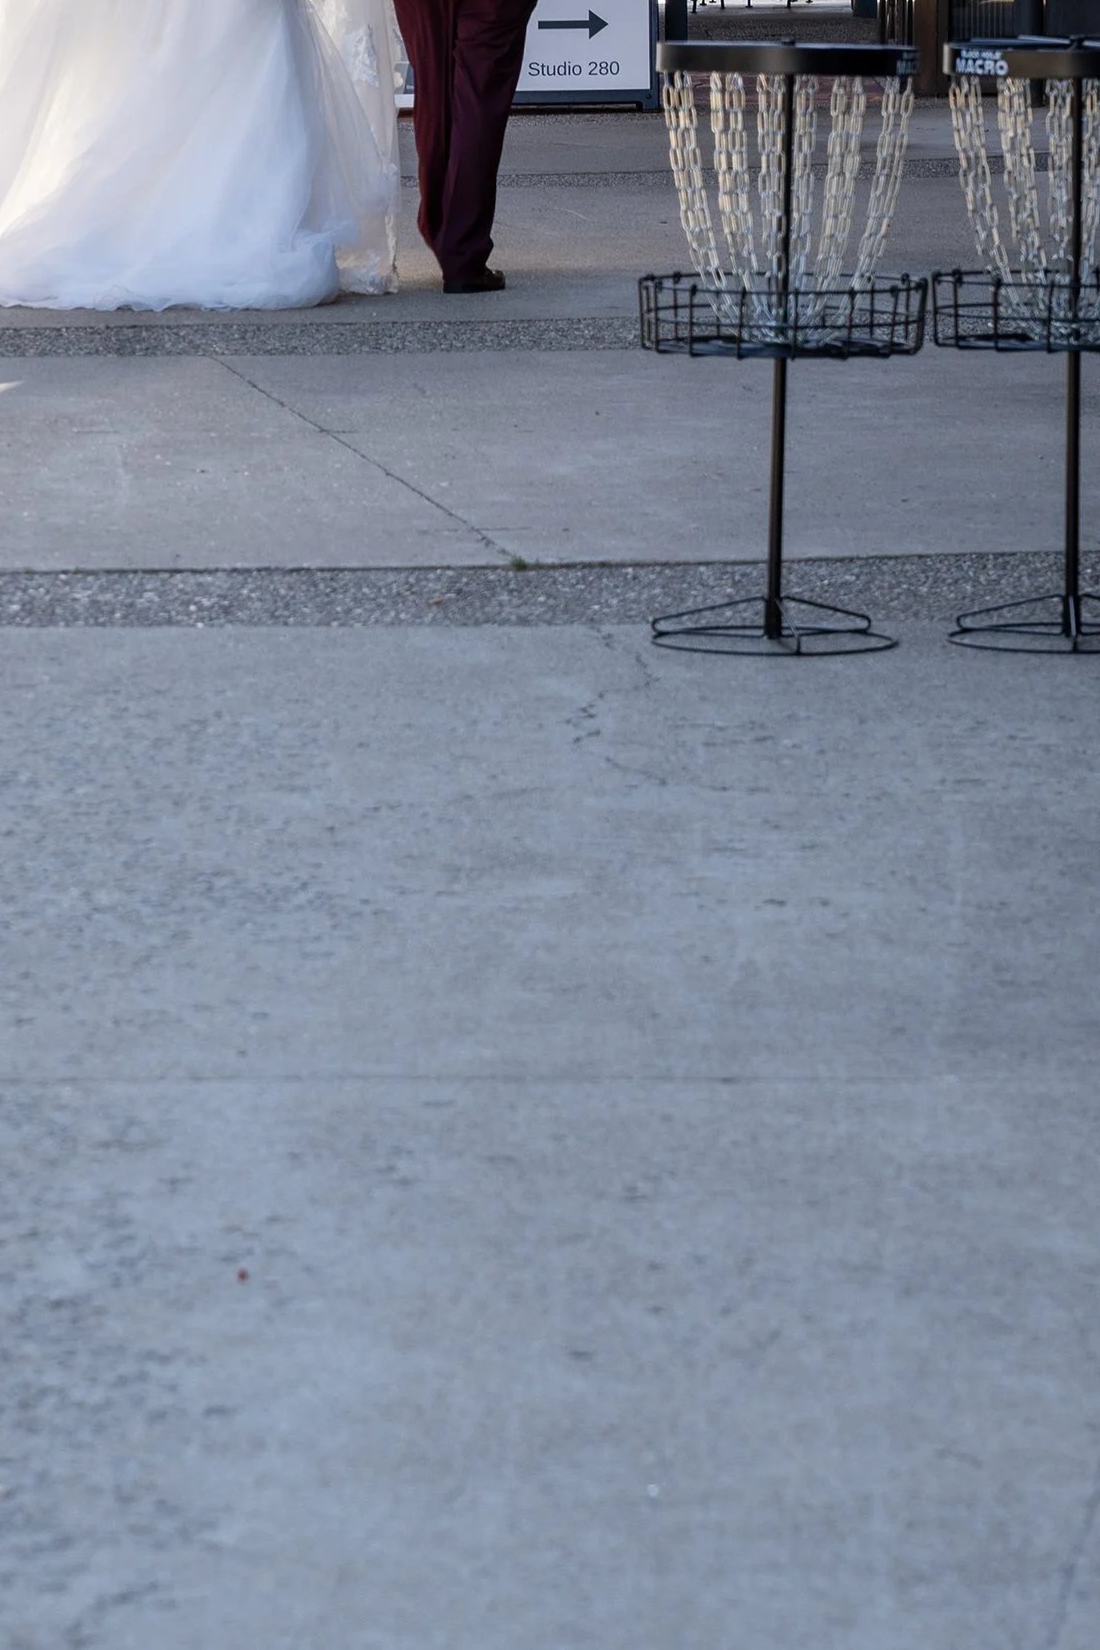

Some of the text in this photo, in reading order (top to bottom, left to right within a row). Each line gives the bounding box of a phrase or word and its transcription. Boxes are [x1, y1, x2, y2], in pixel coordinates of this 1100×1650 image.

[528, 60, 620, 76] Studio 280
[956, 57, 1009, 76] MACRO
